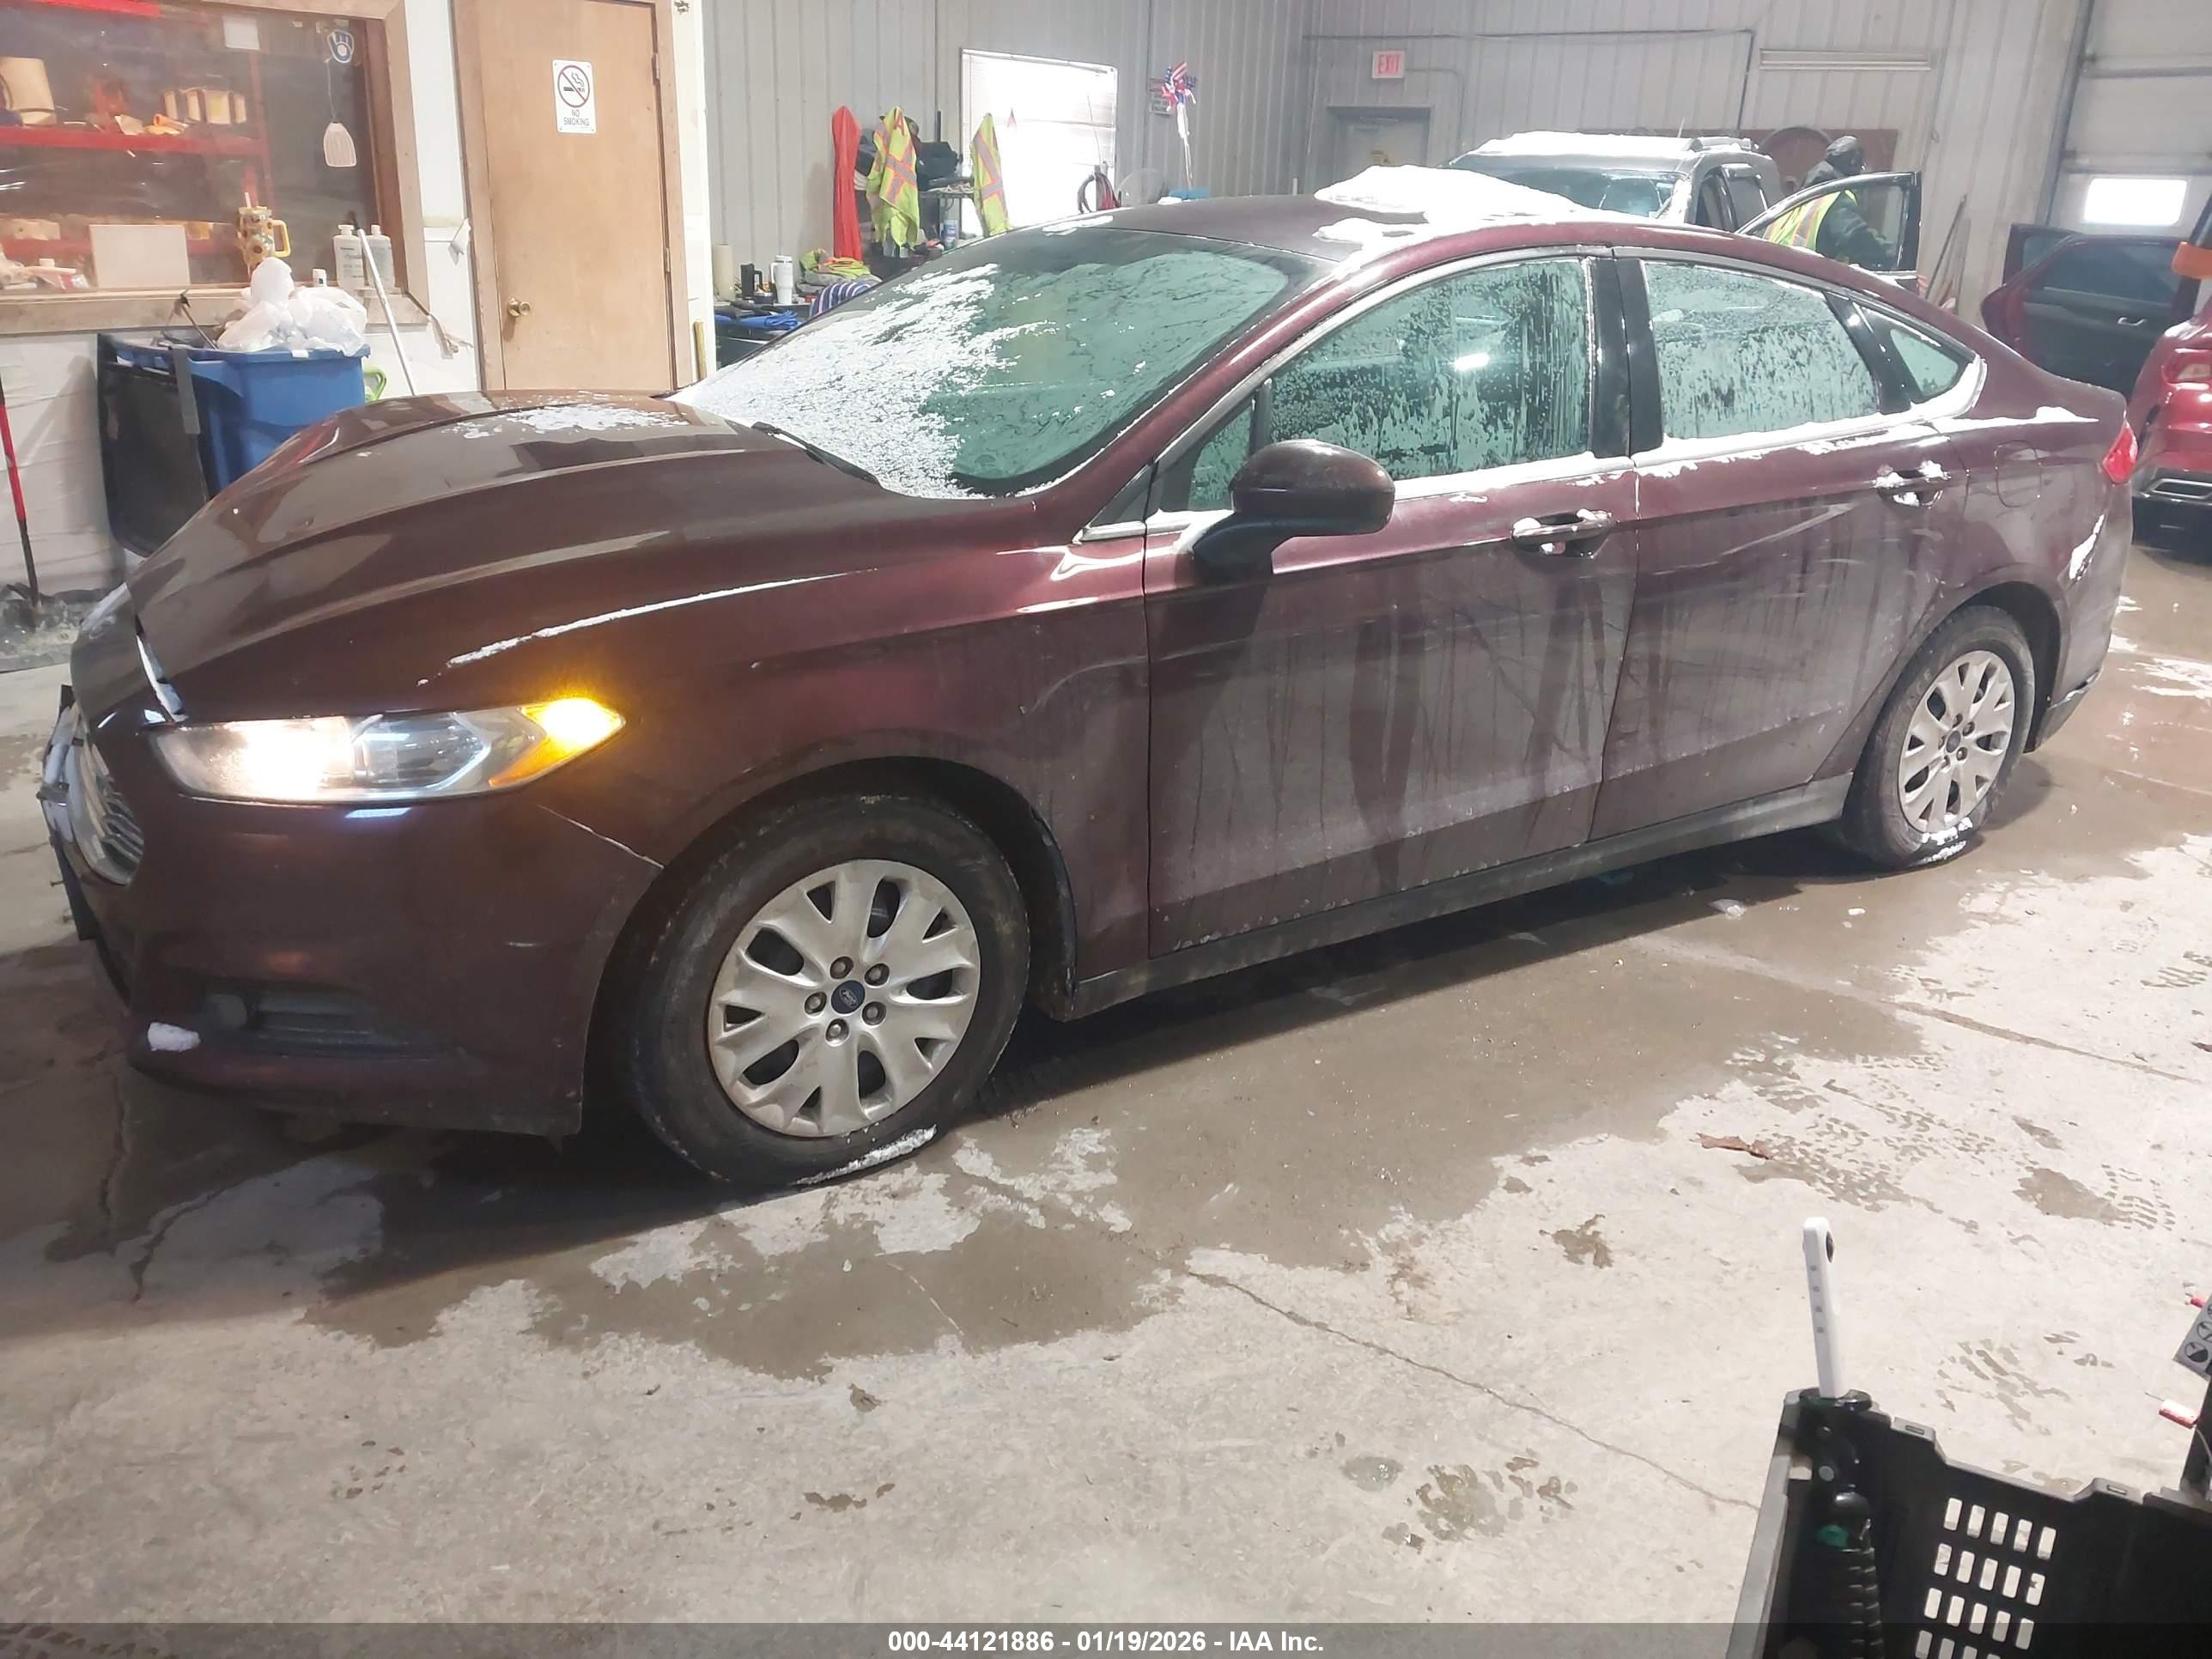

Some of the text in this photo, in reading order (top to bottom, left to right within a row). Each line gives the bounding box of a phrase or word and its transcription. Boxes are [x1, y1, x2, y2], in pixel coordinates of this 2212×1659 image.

[1377, 54, 1401, 75] EXIT
[571, 109, 580, 118] NO
[563, 118, 590, 126] SMOKING
